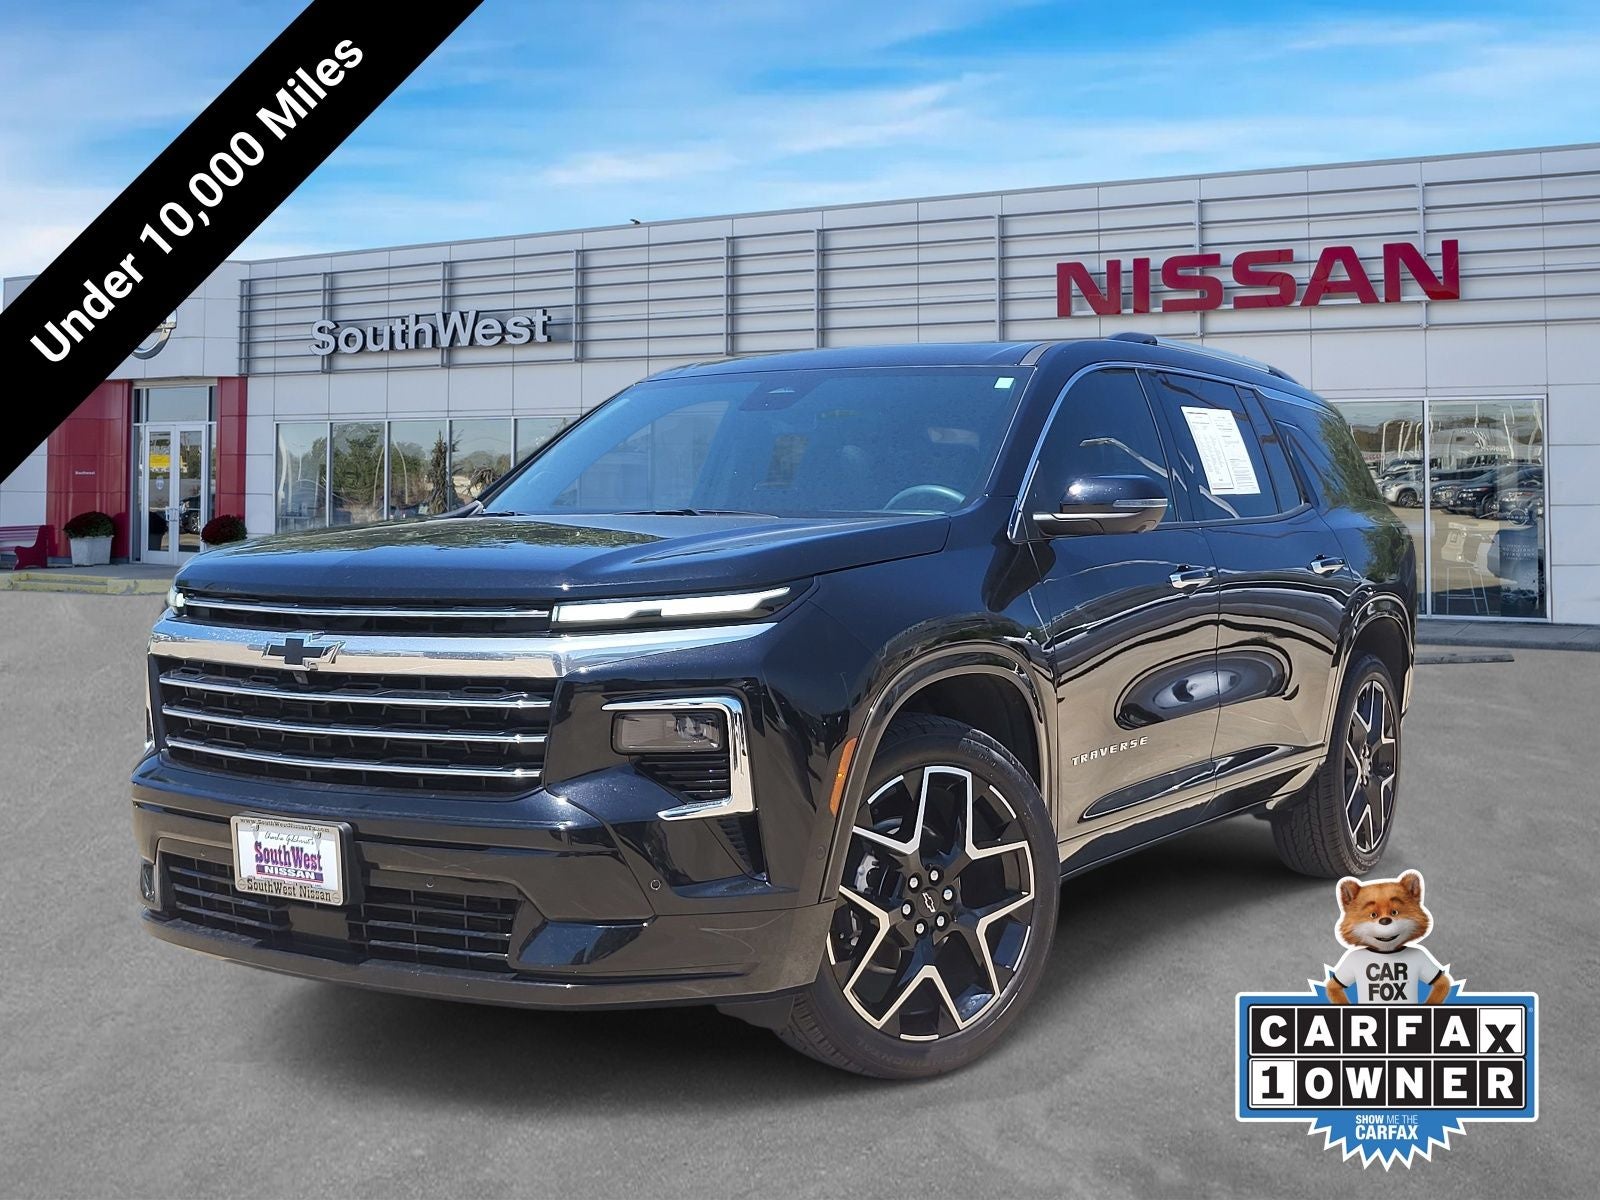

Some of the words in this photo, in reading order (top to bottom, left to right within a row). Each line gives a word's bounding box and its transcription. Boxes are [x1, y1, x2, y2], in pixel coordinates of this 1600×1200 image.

[1056, 239, 1460, 318] NISSAN
[310, 308, 552, 356] SouthWest
[1071, 735, 1149, 767] TRAVERSE
[254, 840, 323, 871] SouthWest
[264, 864, 316, 880] NISSAN
[246, 878, 297, 896] SouthWest
[299, 882, 332, 901] Nissan
